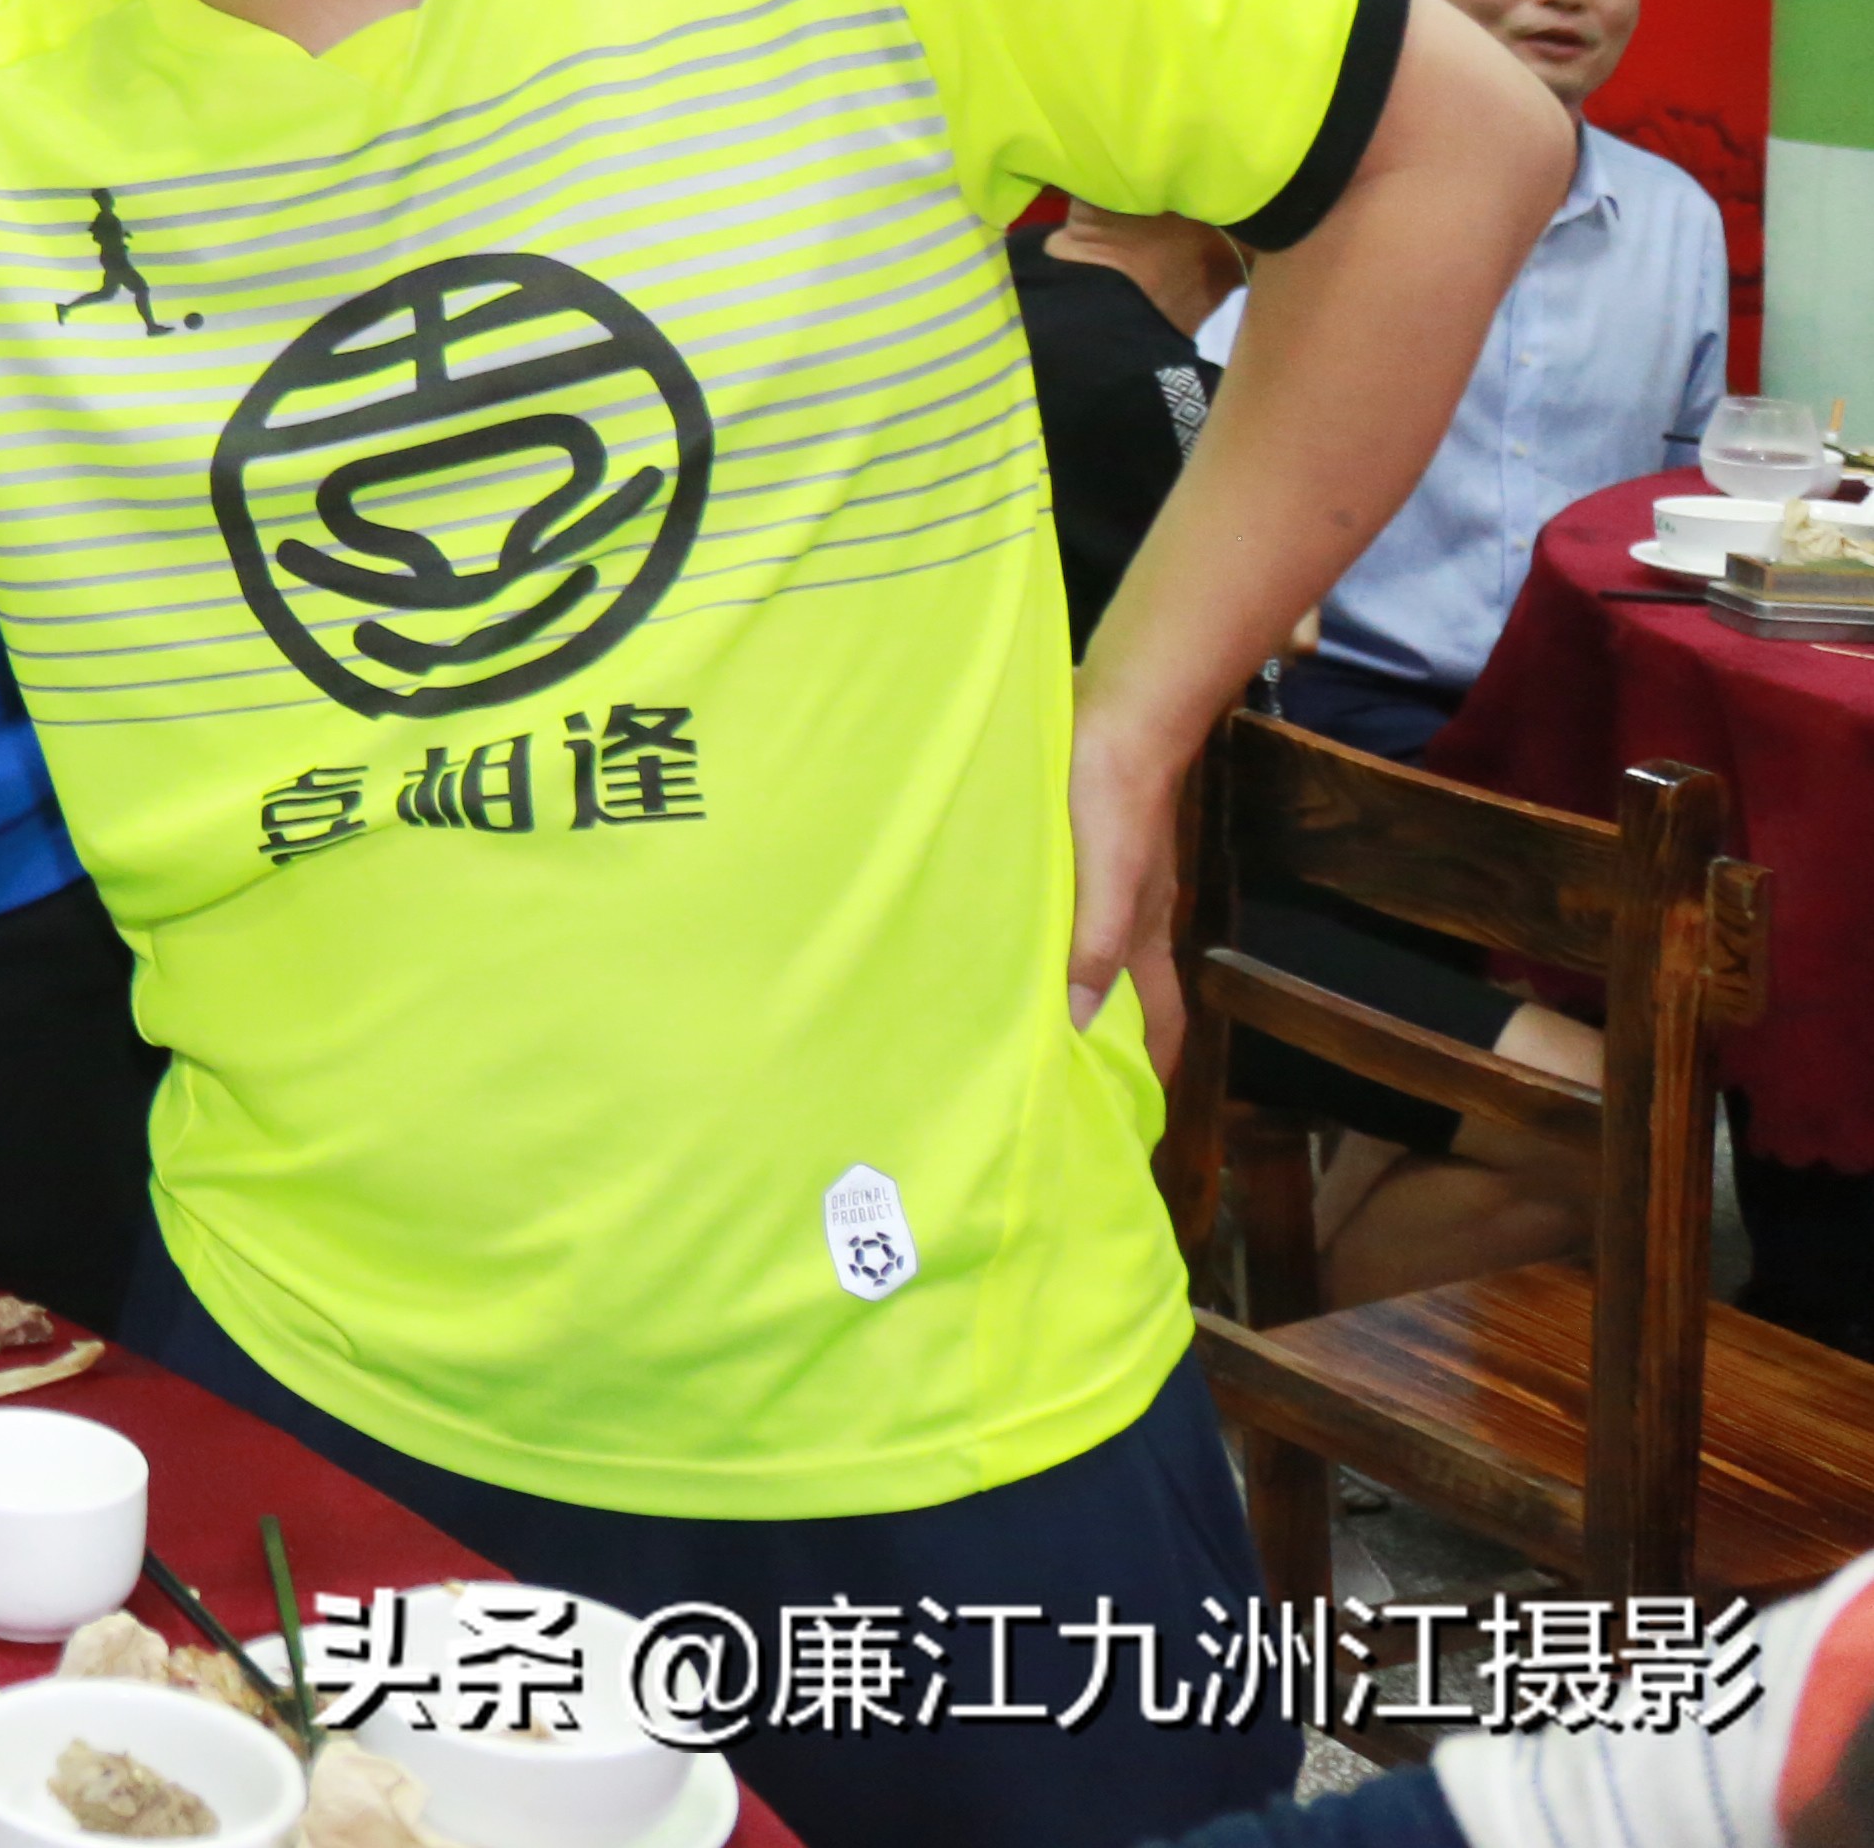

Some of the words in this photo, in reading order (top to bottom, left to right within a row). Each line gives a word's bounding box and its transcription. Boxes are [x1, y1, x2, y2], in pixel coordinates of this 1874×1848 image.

[258, 703, 707, 866] 喜相逢
[831, 1186, 891, 1211] ORIGINAL
[831, 1202, 894, 1226] PRODUCT
